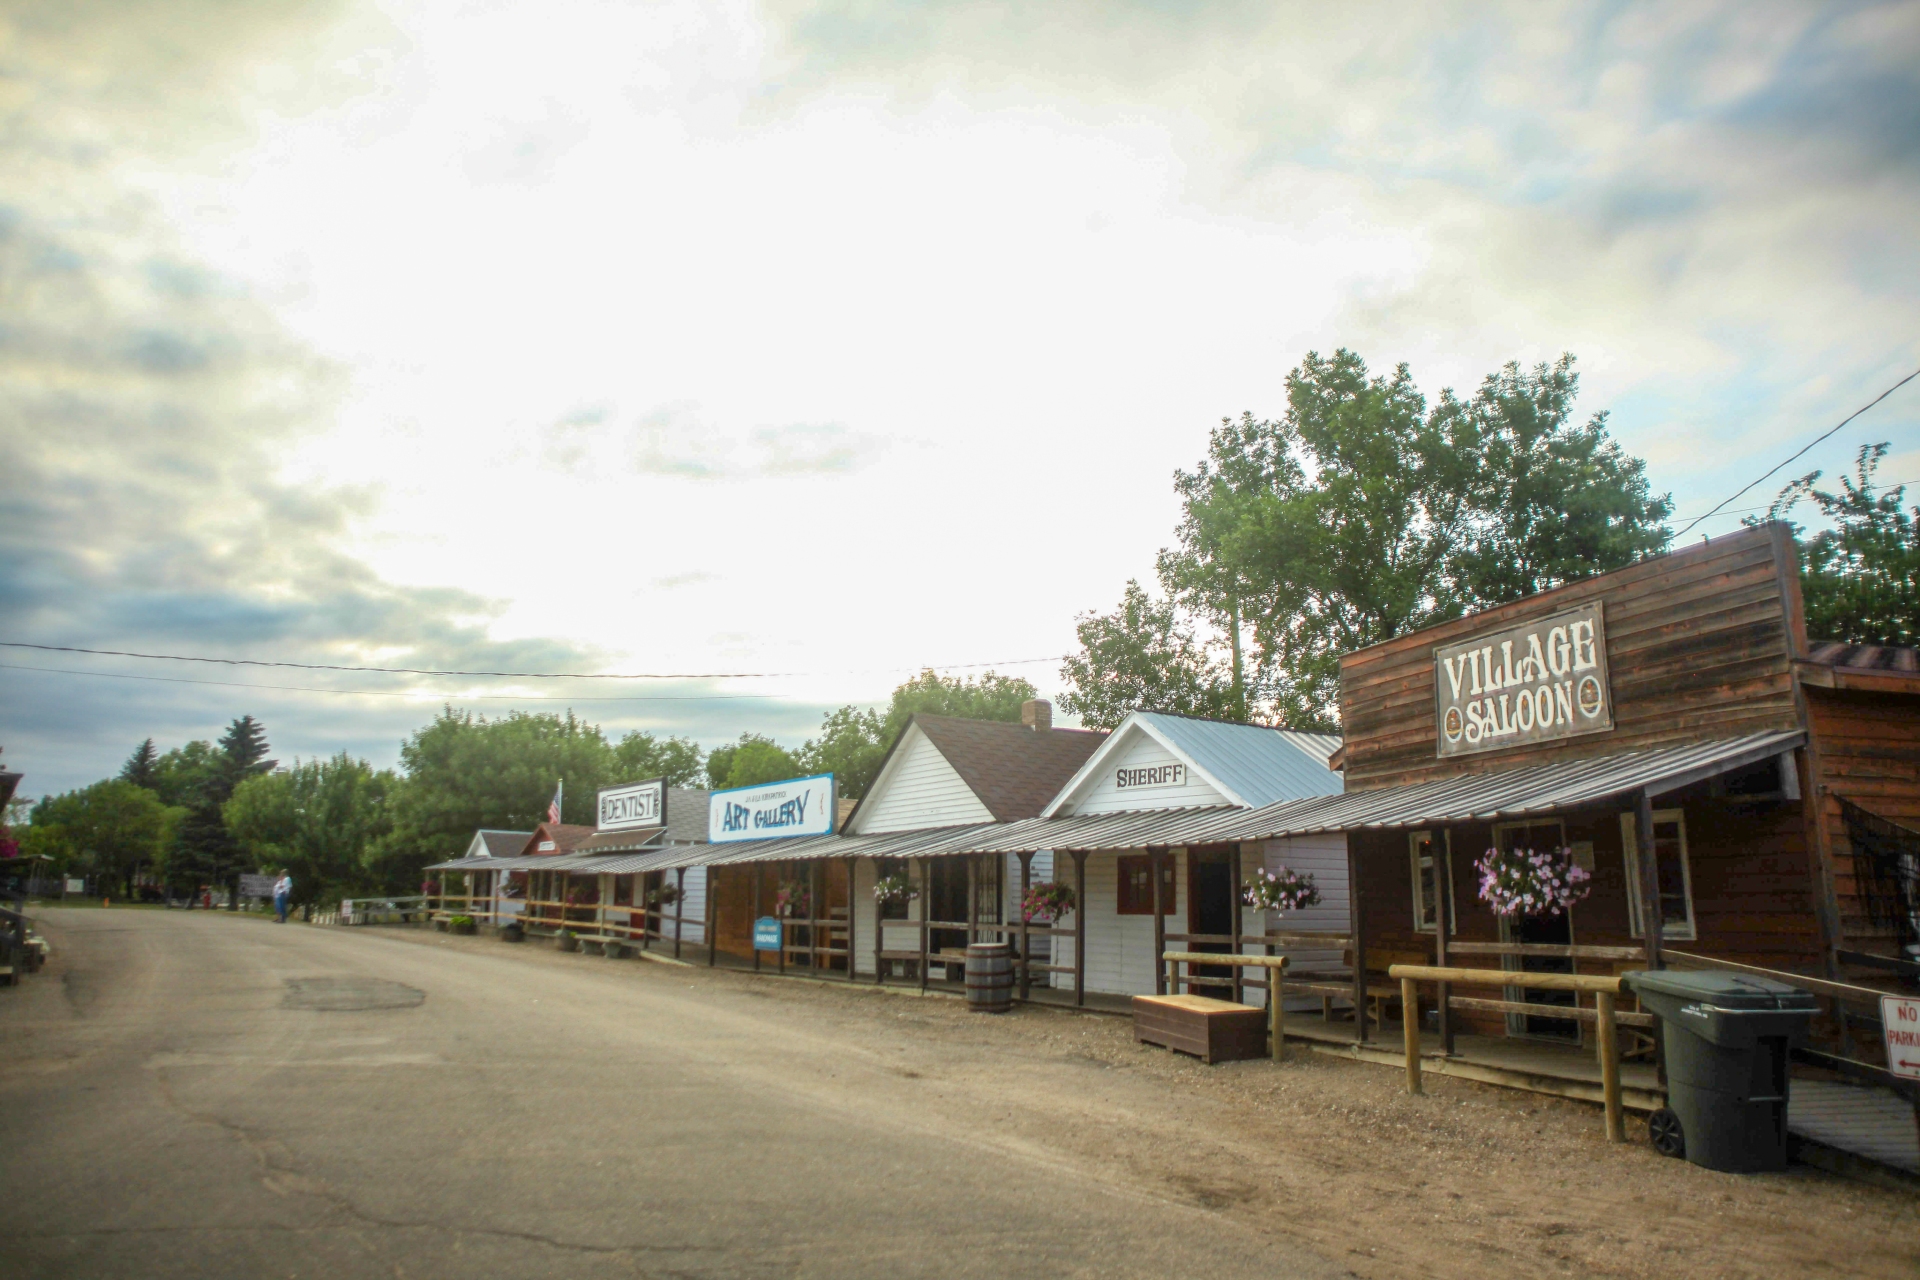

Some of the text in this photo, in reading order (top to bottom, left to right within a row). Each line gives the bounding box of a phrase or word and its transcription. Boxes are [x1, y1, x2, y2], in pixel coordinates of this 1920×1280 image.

[1443, 618, 1597, 699] VILLAGE
[1465, 680, 1574, 743] SALOON
[1116, 763, 1183, 788] SHERIFF
[607, 793, 653, 820] DENTIST
[722, 788, 811, 832] ART GALLERY
[1897, 1006, 1918, 1023] NO
